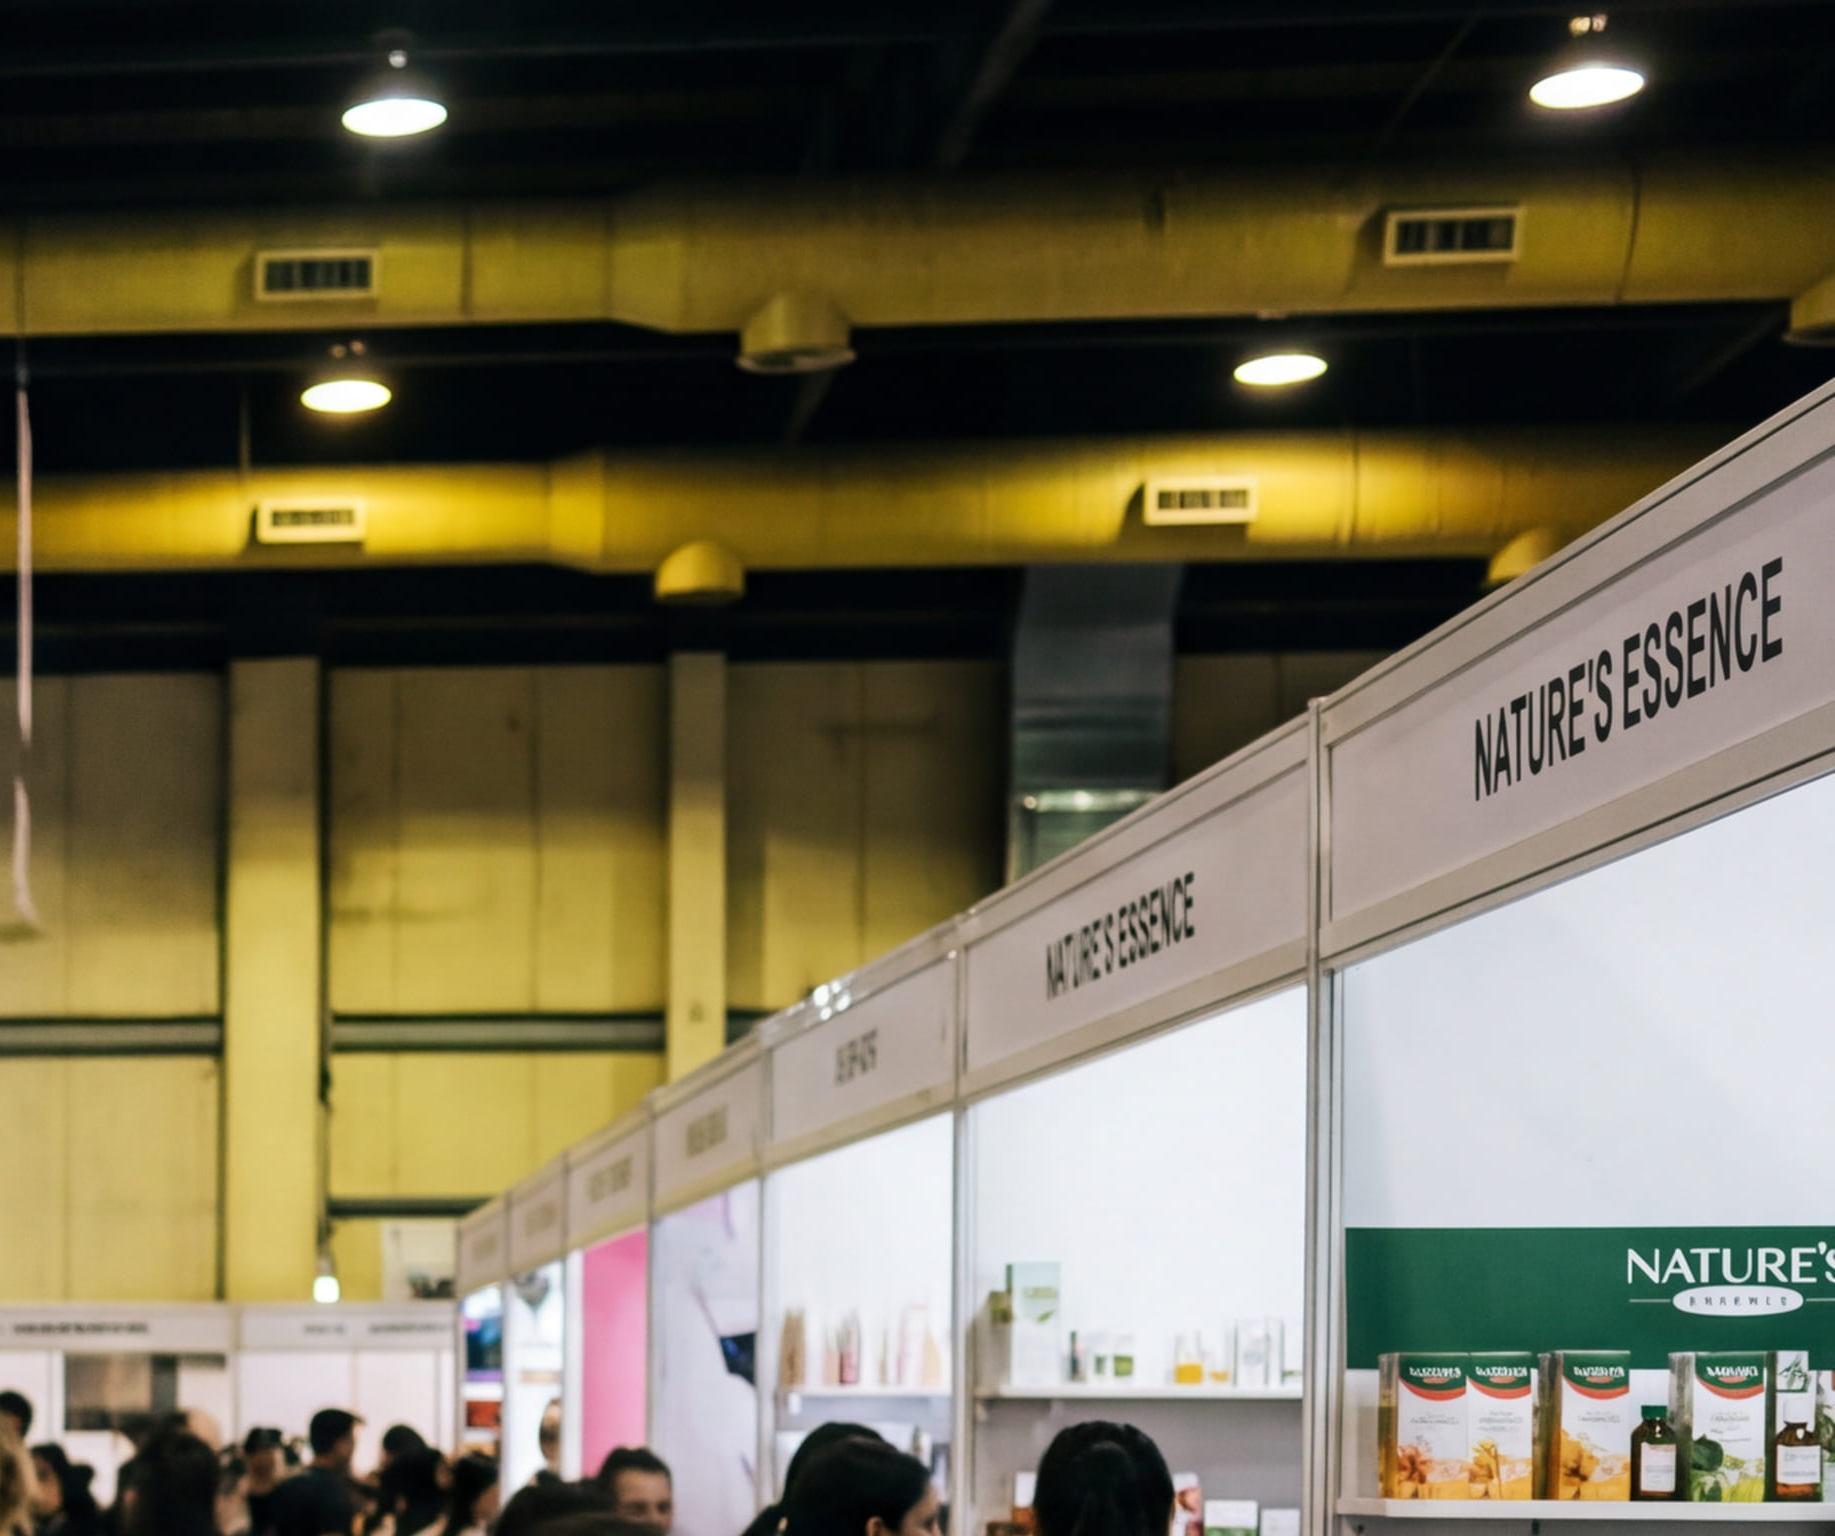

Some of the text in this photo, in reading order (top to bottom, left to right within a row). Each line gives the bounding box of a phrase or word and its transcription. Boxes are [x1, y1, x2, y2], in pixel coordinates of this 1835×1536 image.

[1474, 555, 1784, 802] NATURE'S ESSENCE
[1117, 870, 1196, 969] ESSENCE
